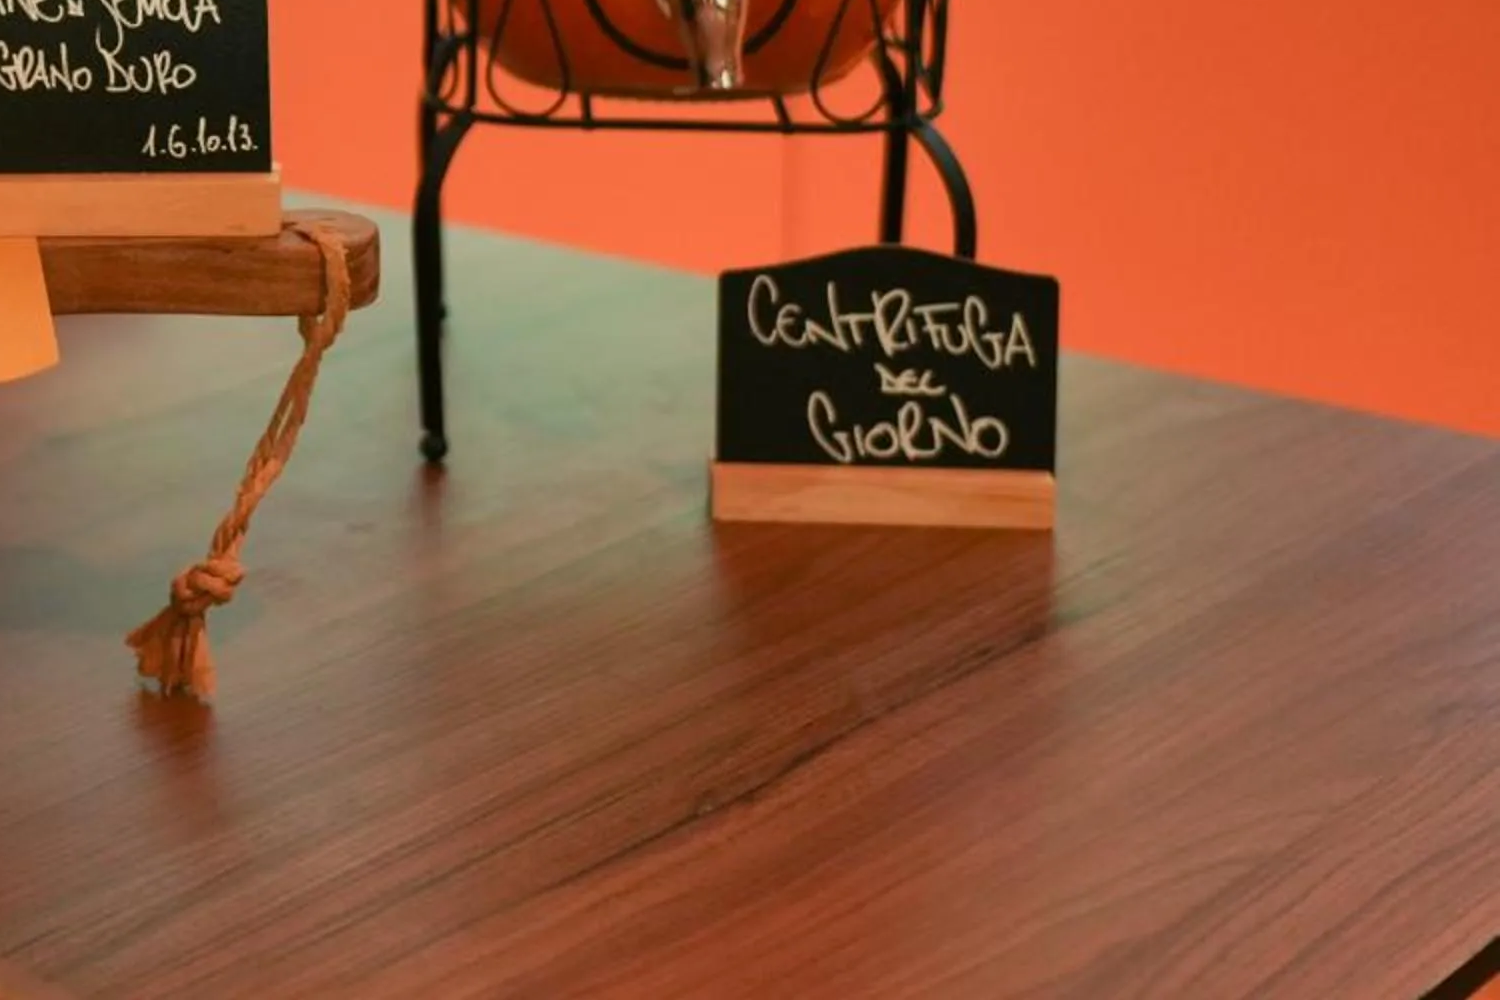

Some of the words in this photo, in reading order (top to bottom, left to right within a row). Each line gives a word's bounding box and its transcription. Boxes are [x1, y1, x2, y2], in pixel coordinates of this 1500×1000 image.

[100, 49, 197, 95] DURO
[747, 274, 1036, 369] CENTRIFUGA
[873, 362, 947, 395] DEL
[807, 391, 1010, 463] GIORNO
